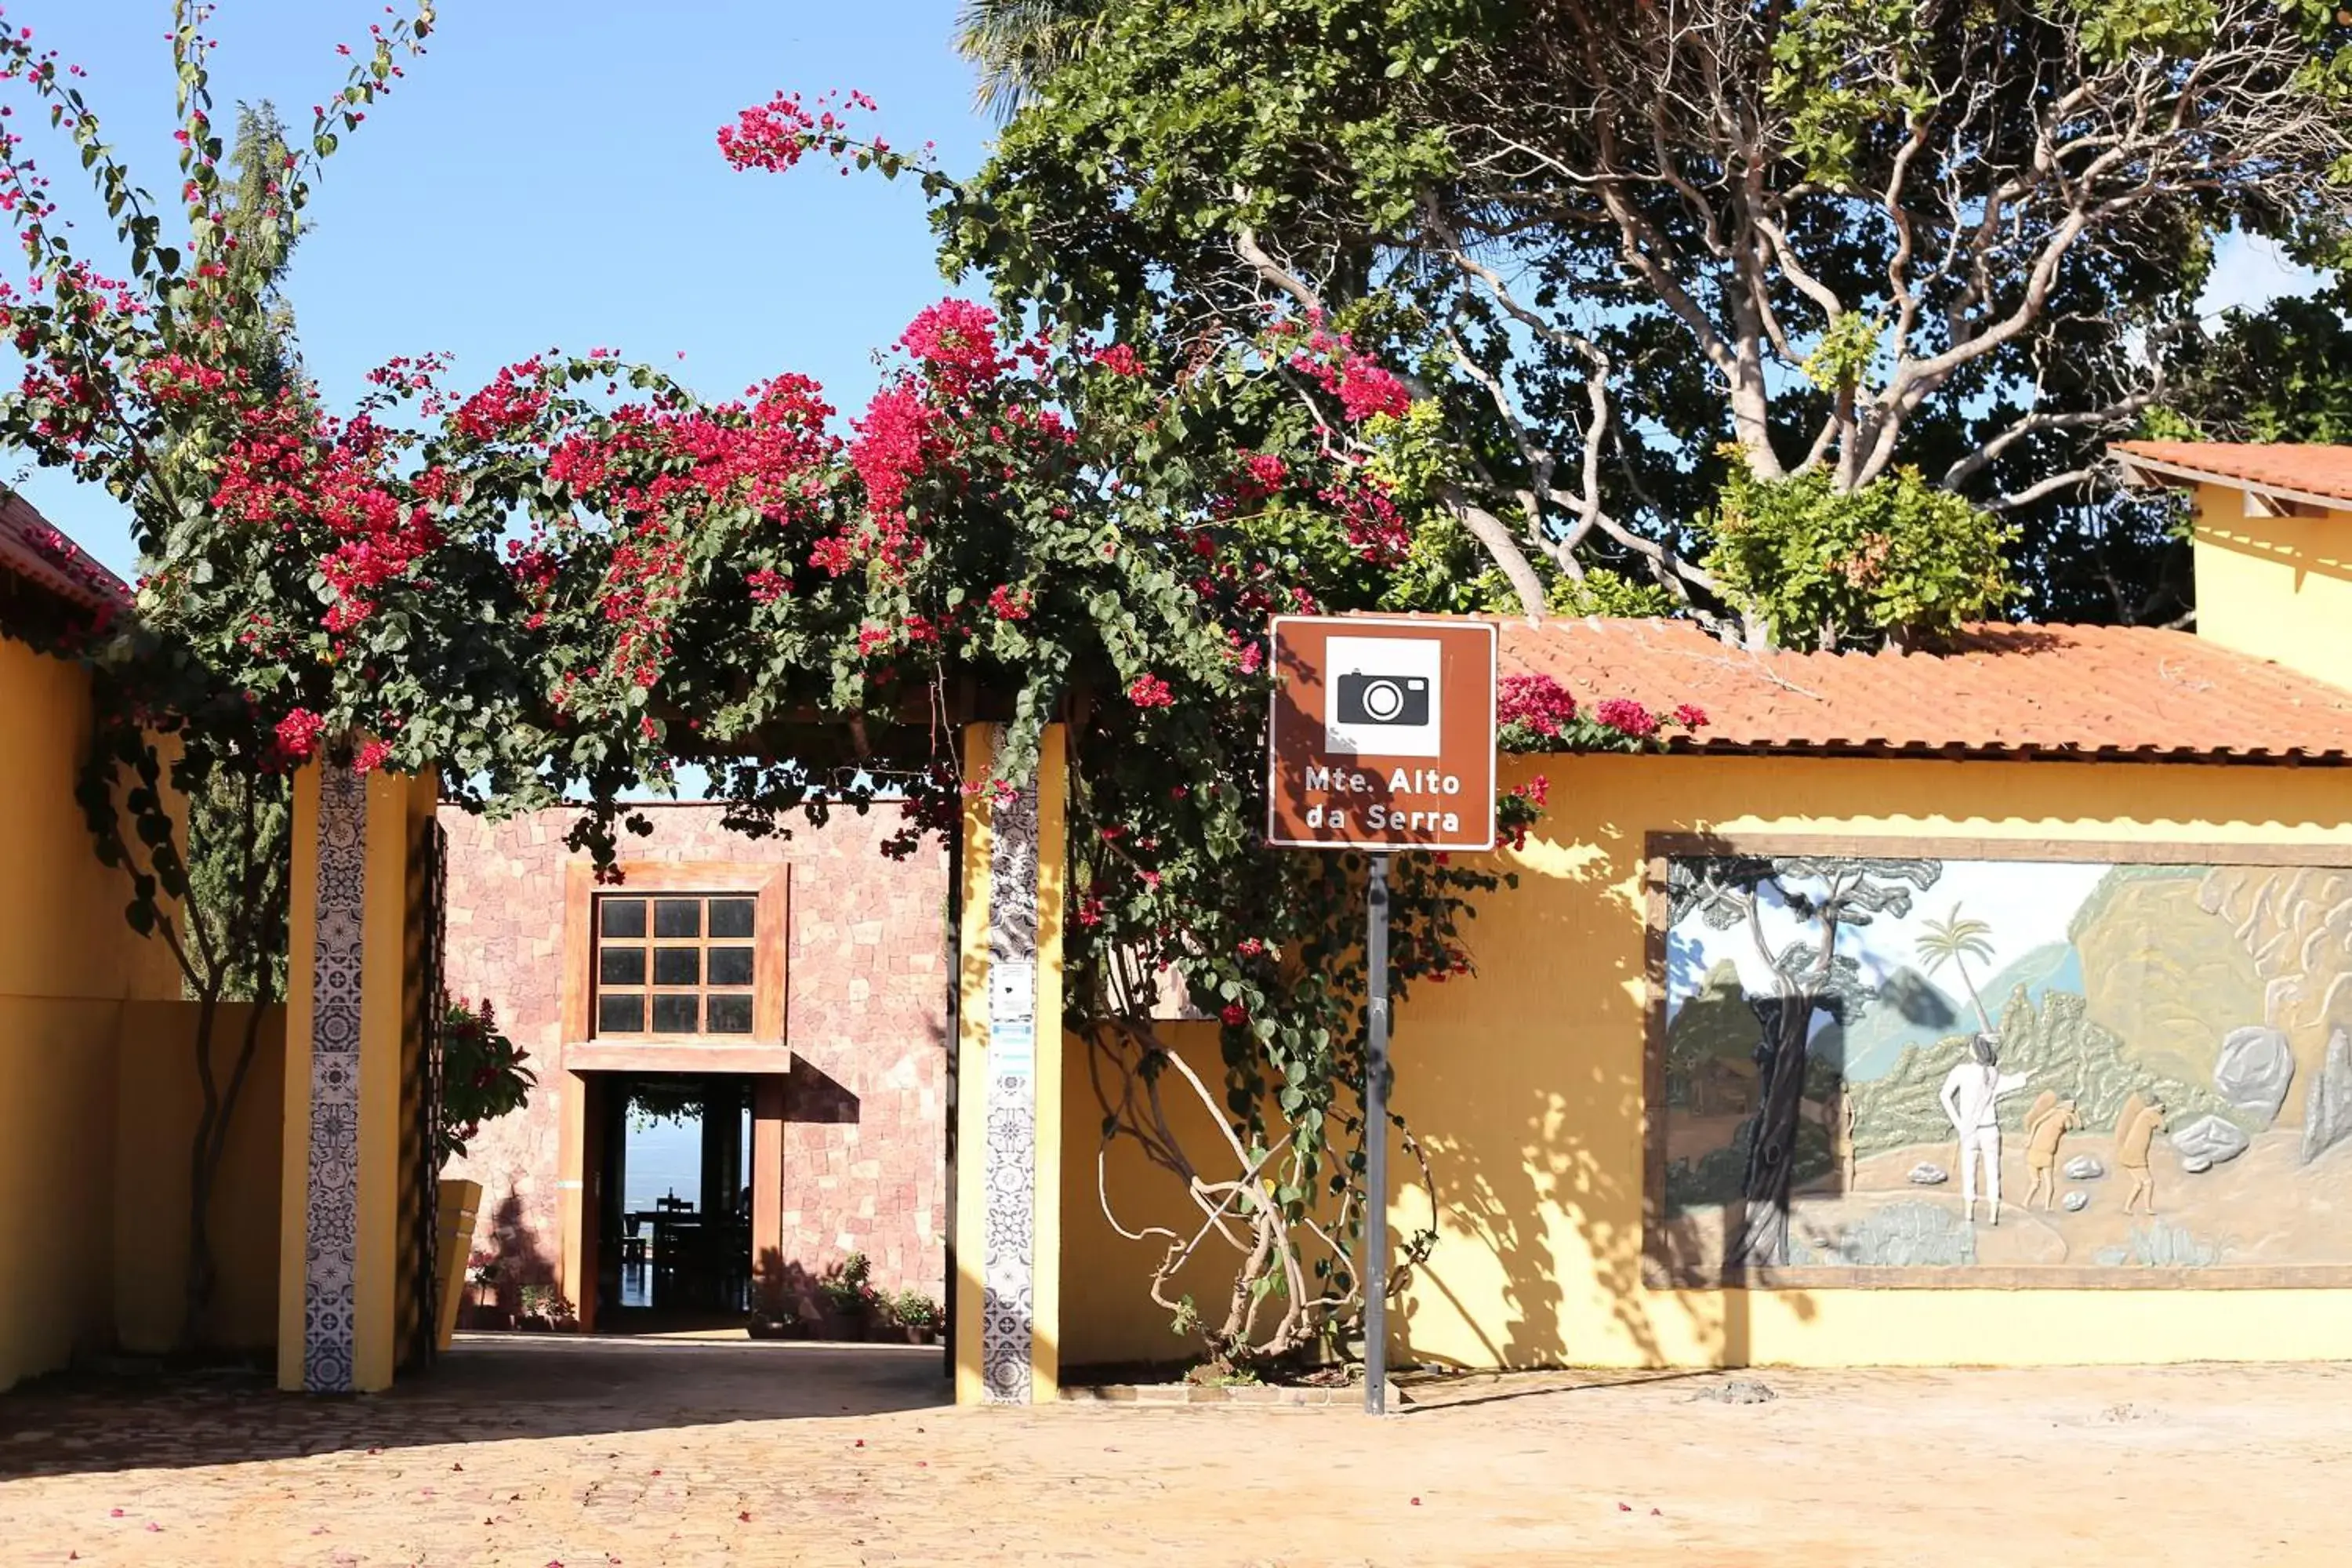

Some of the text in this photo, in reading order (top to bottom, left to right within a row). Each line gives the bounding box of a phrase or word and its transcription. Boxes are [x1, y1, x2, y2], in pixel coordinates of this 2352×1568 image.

[1305, 766, 1460, 794] Mte. Alto
[1305, 804, 1459, 832] da Serra
